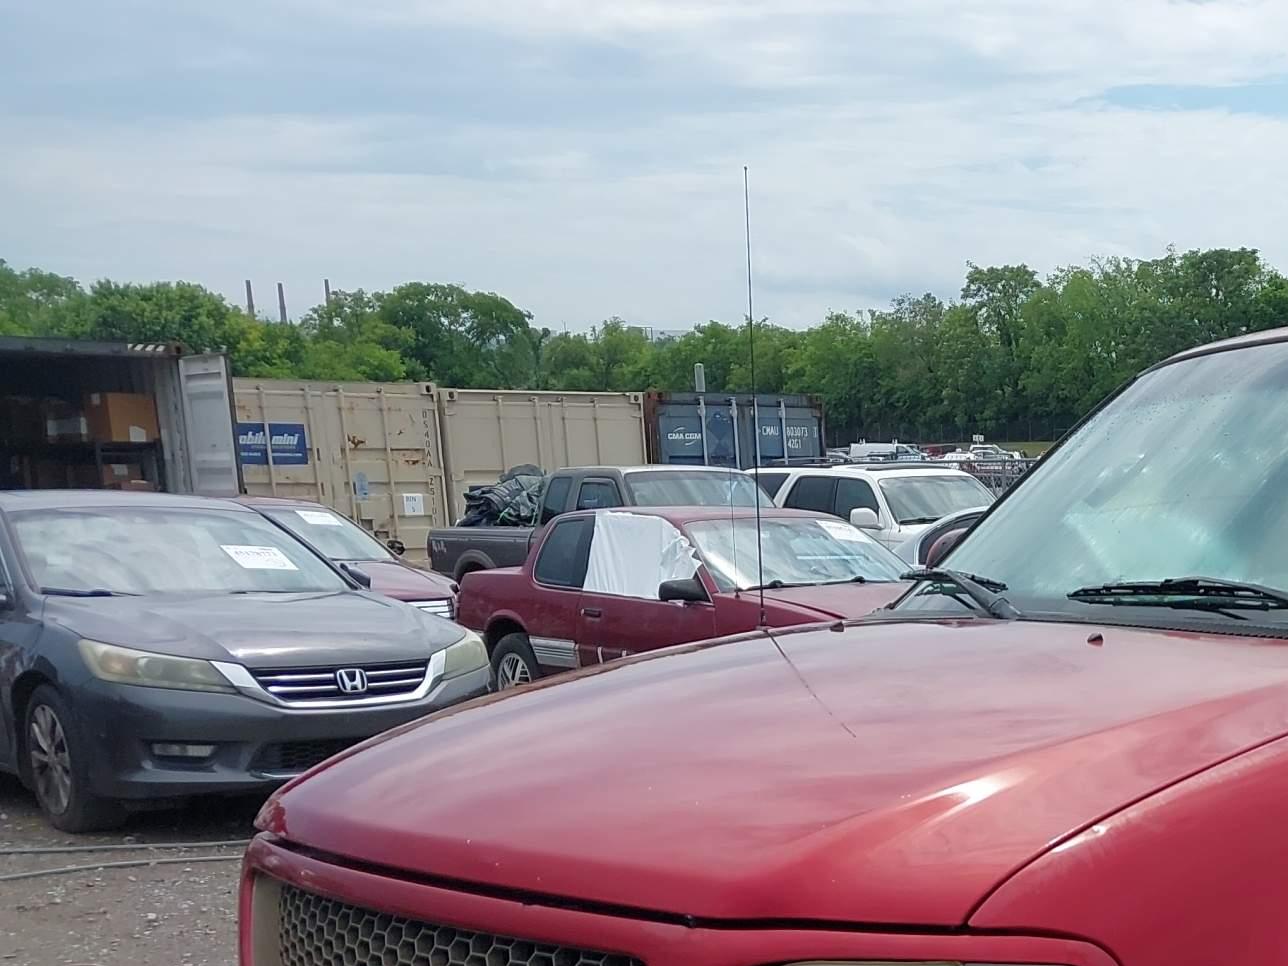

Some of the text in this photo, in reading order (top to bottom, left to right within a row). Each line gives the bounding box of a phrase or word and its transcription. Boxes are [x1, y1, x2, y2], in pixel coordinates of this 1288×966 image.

[667, 432, 701, 440] CMA CGM
[761, 425, 779, 436] CMAU
[271, 433, 299, 445] mini
